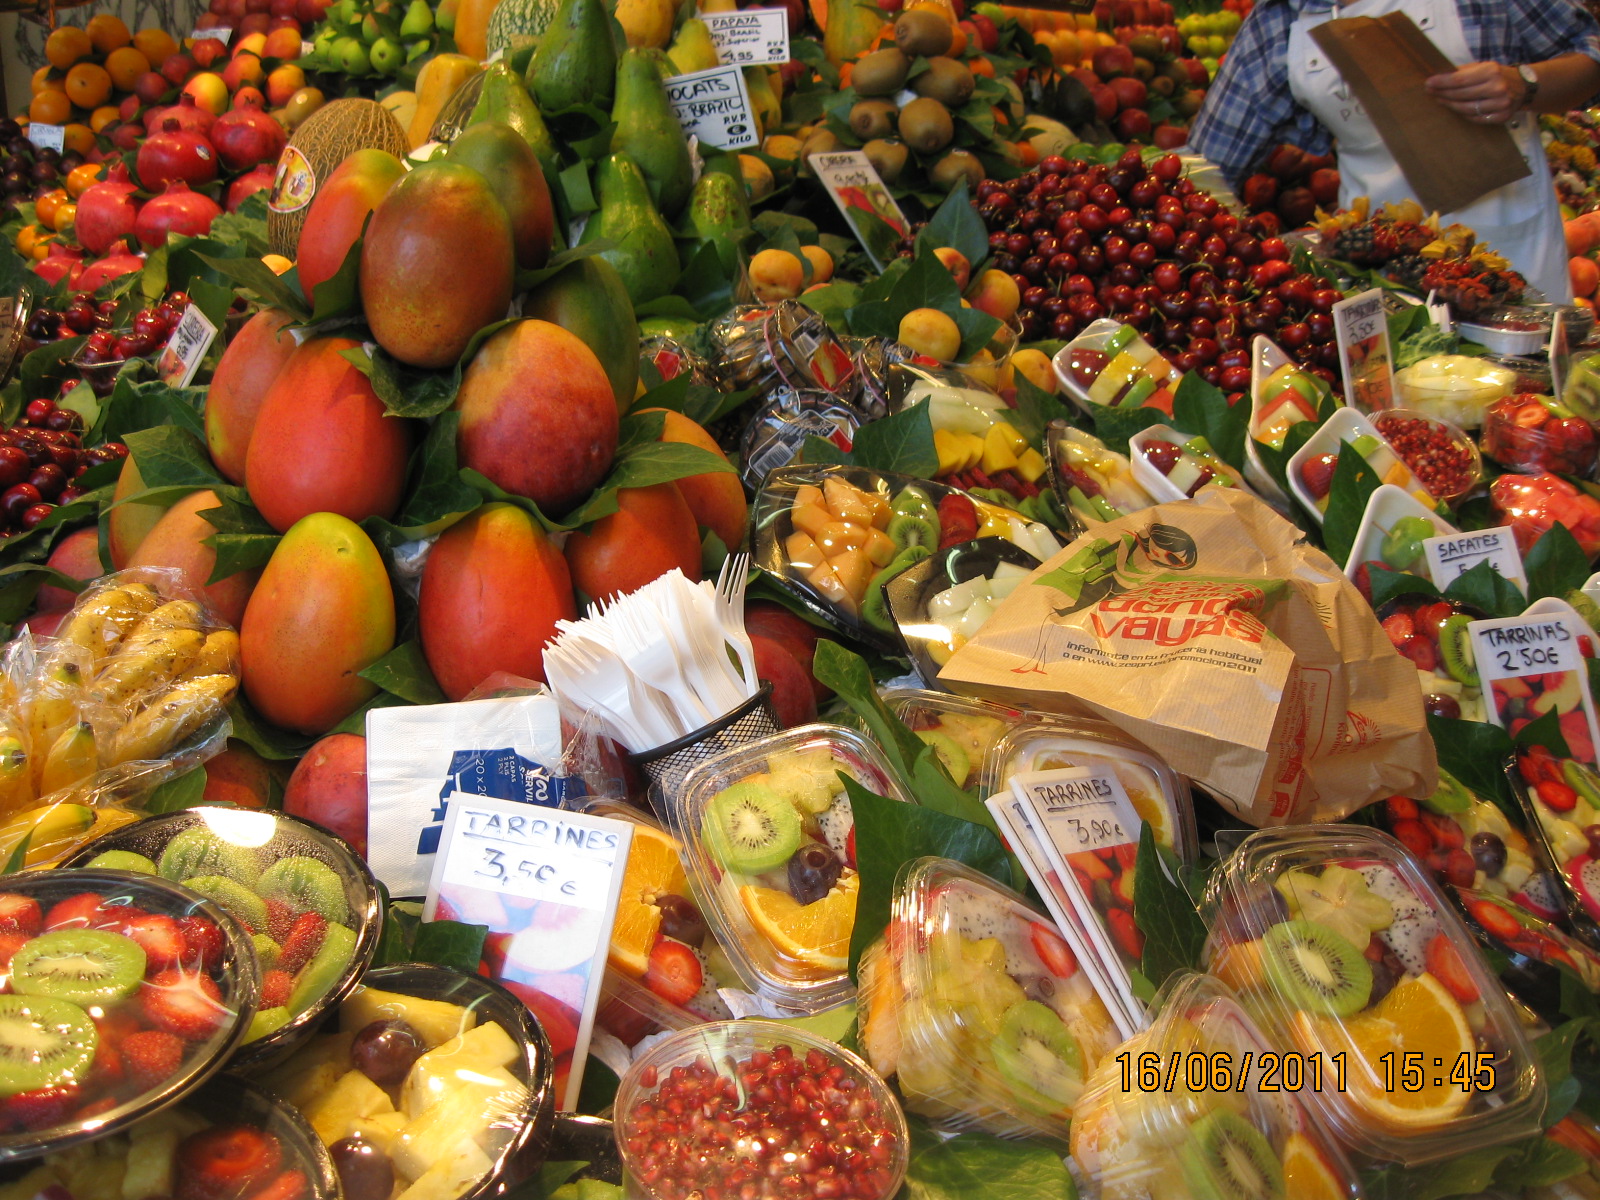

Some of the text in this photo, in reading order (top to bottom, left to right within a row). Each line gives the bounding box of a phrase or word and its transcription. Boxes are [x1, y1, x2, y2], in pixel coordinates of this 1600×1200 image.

[729, 134, 752, 145] KILO
[1438, 534, 1499, 558] SAFATES
[1089, 613, 1263, 647] vayas
[1479, 621, 1571, 648] TARRINAS
[1072, 654, 1086, 662] en
[1209, 648, 1263, 666] habitual
[475, 758, 485, 775] 20
[1034, 779, 1112, 806] TARRINES
[464, 810, 619, 850] TARRINES
